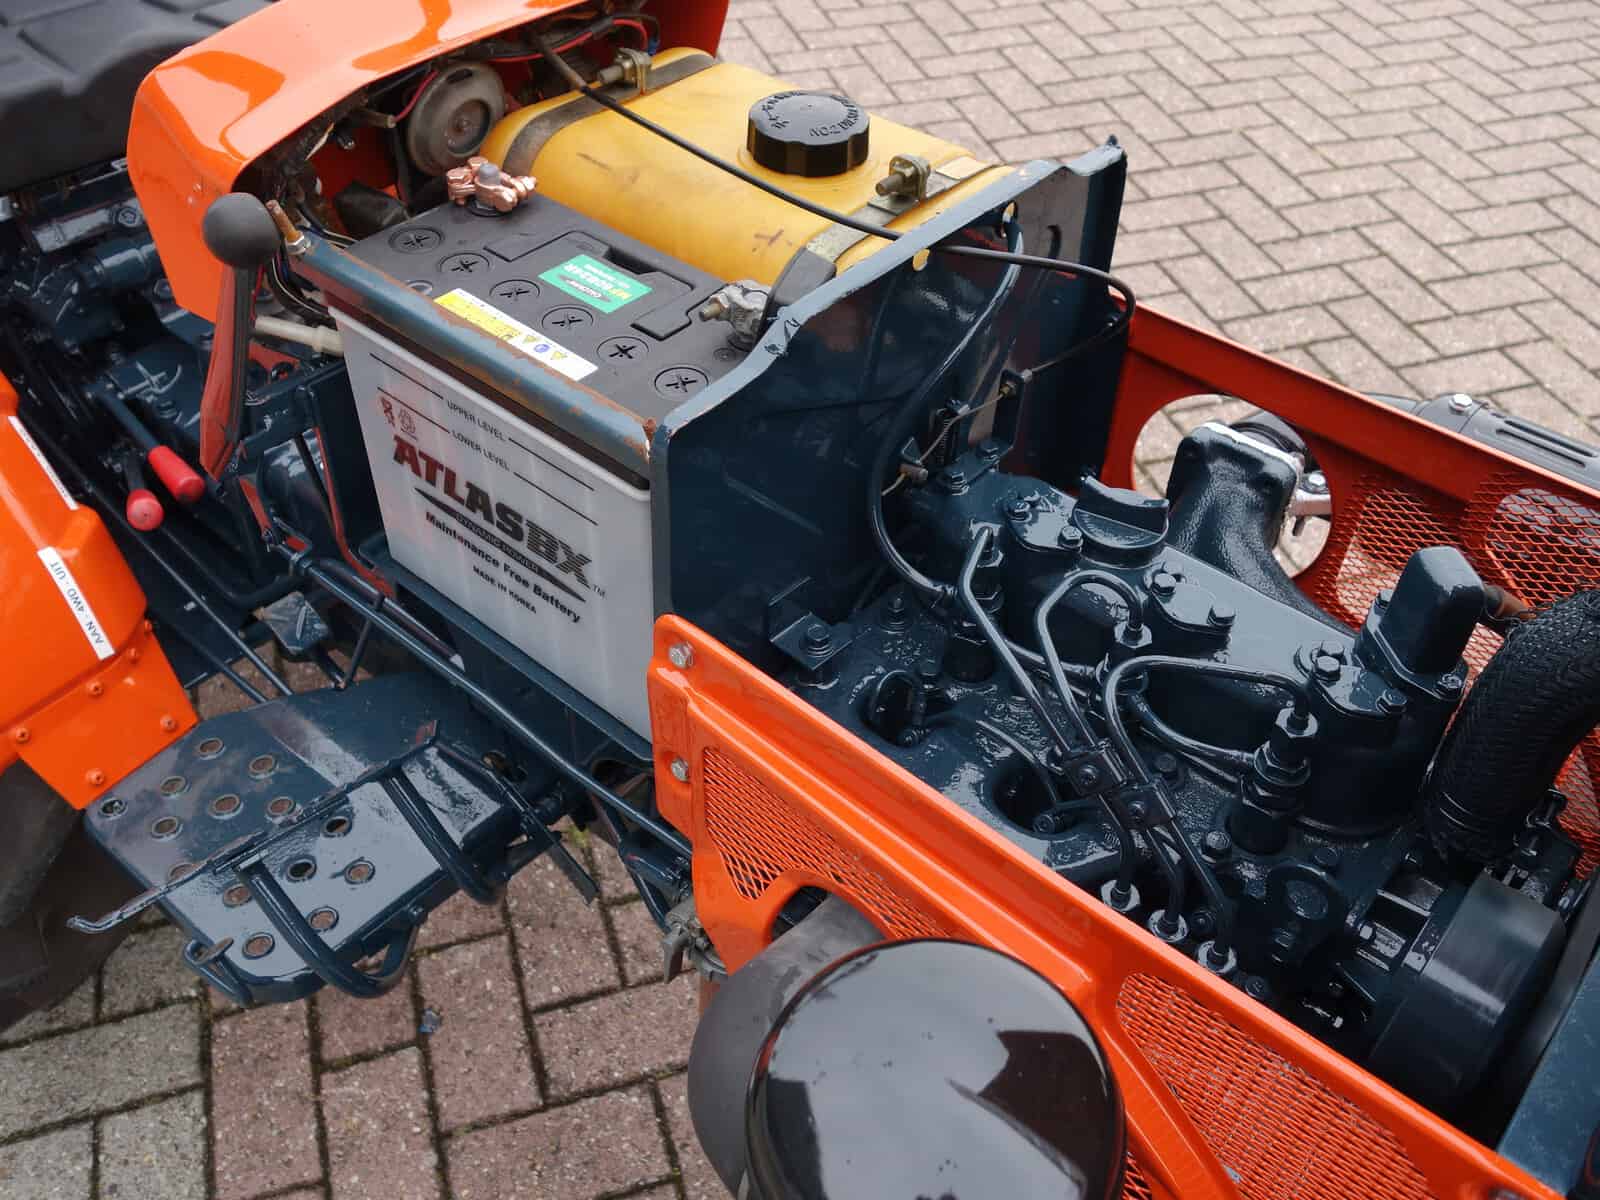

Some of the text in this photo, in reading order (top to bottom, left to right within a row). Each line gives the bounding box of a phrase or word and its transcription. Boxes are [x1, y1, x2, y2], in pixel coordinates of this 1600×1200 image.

[447, 401, 506, 442] UPPER LEVEL
[452, 430, 510, 471] LOWER LEVEL
[393, 434, 592, 589] ATLASBX
[50, 561, 66, 580] UIT
[426, 511, 581, 624] Maintenance Free Battery
[473, 565, 496, 587] MADE
[66, 587, 84, 613] 4WD
[85, 620, 104, 644] AAN
